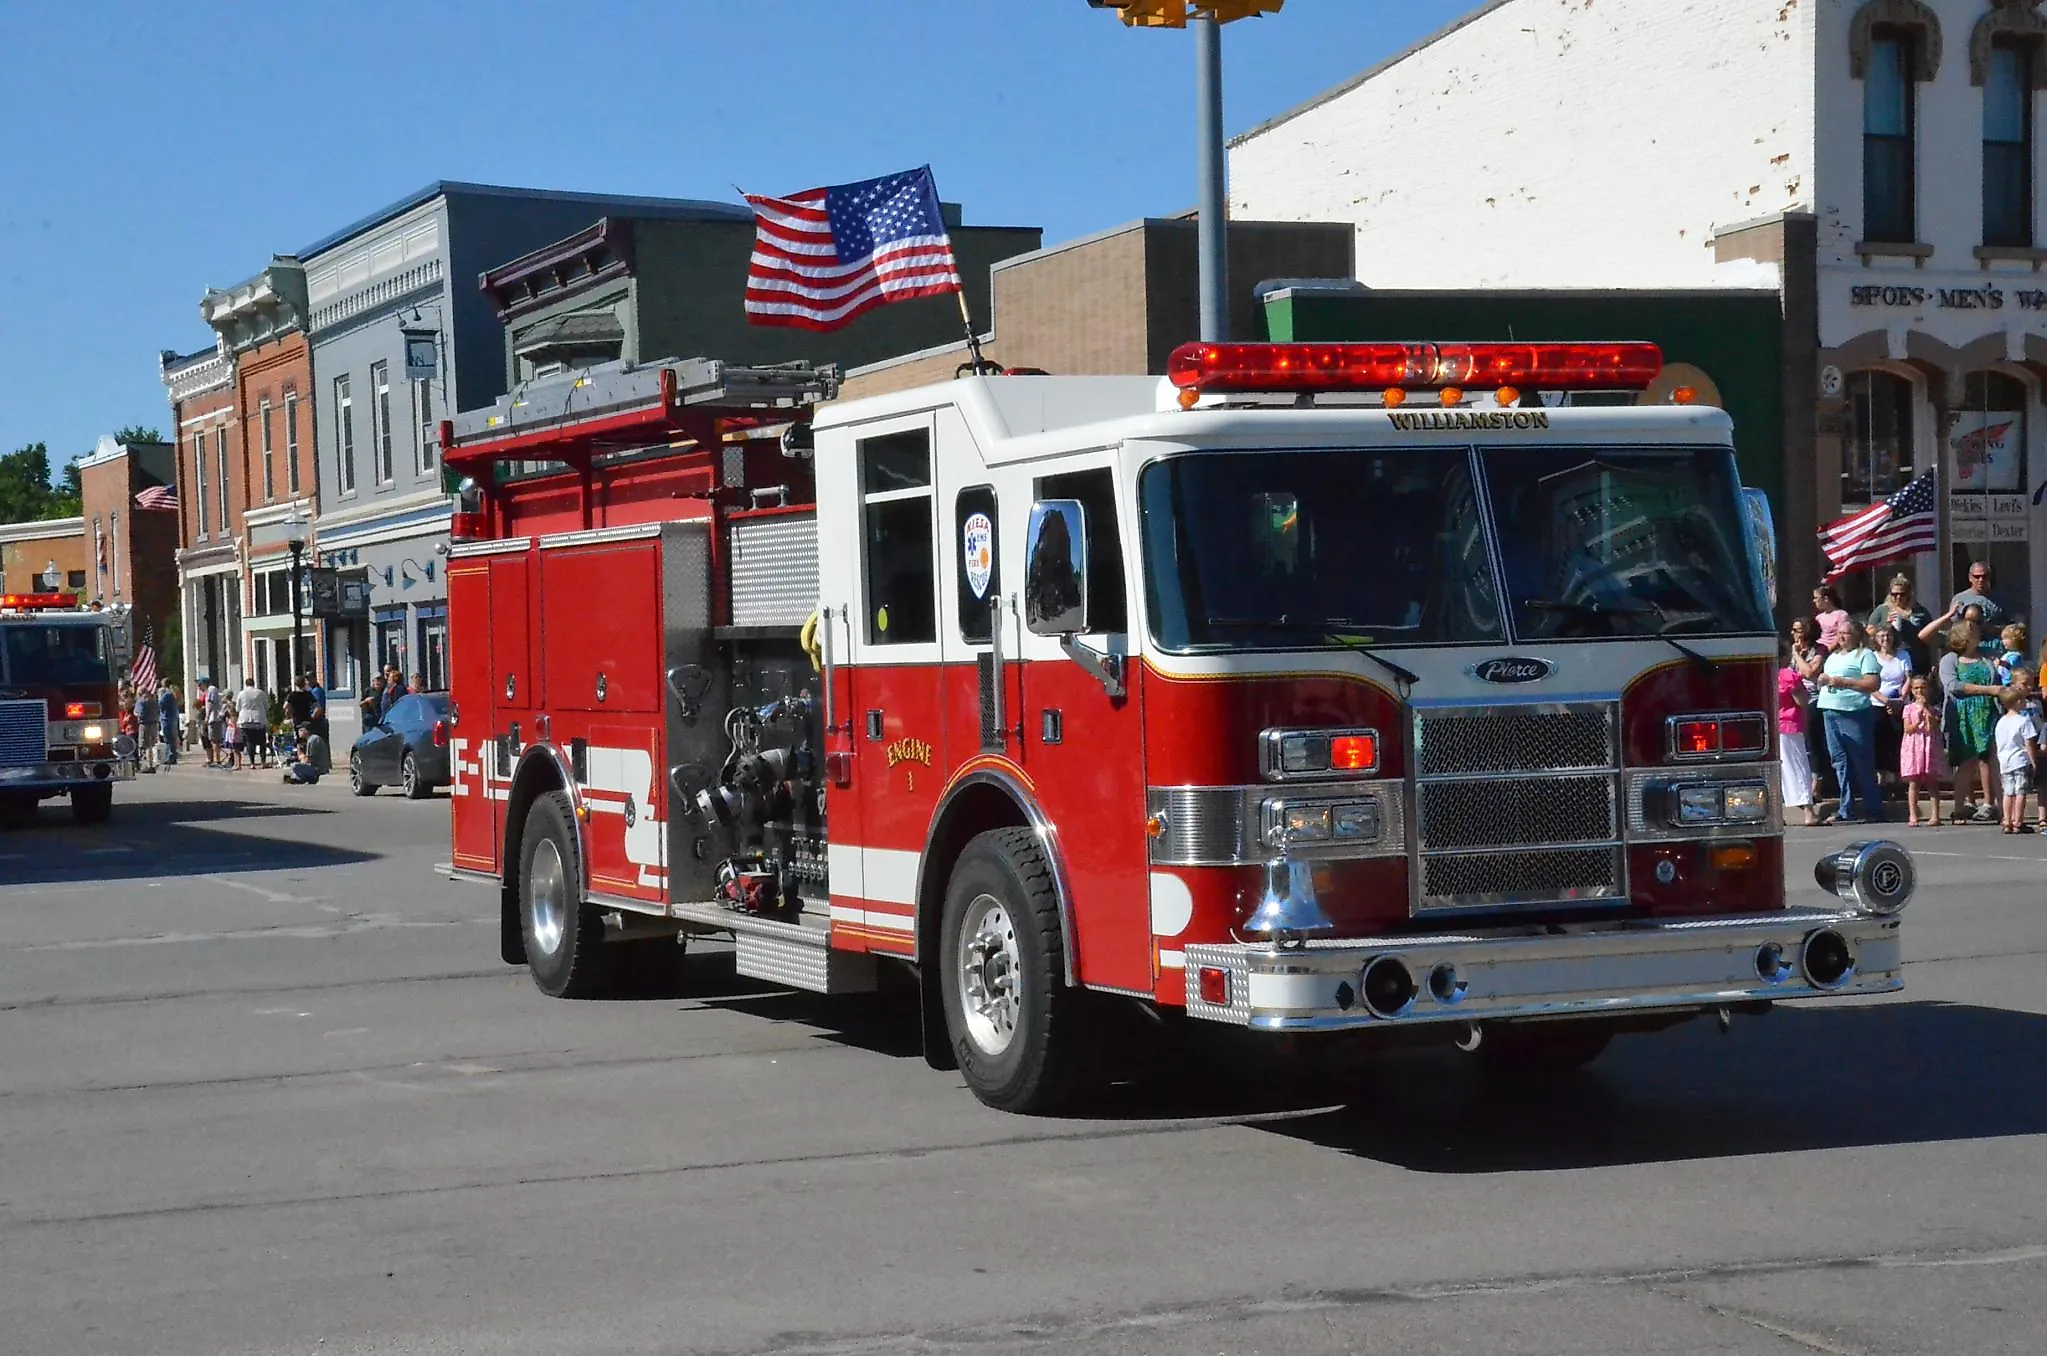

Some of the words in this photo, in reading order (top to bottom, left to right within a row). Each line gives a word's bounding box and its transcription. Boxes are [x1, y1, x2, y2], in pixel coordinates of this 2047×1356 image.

[1938, 282, 2003, 309] MEN'S
[1388, 411, 1550, 431] WILLIAMSTON
[1485, 661, 1538, 680] Pierce
[887, 737, 932, 768] ENGINE
[907, 771, 914, 792] 1
